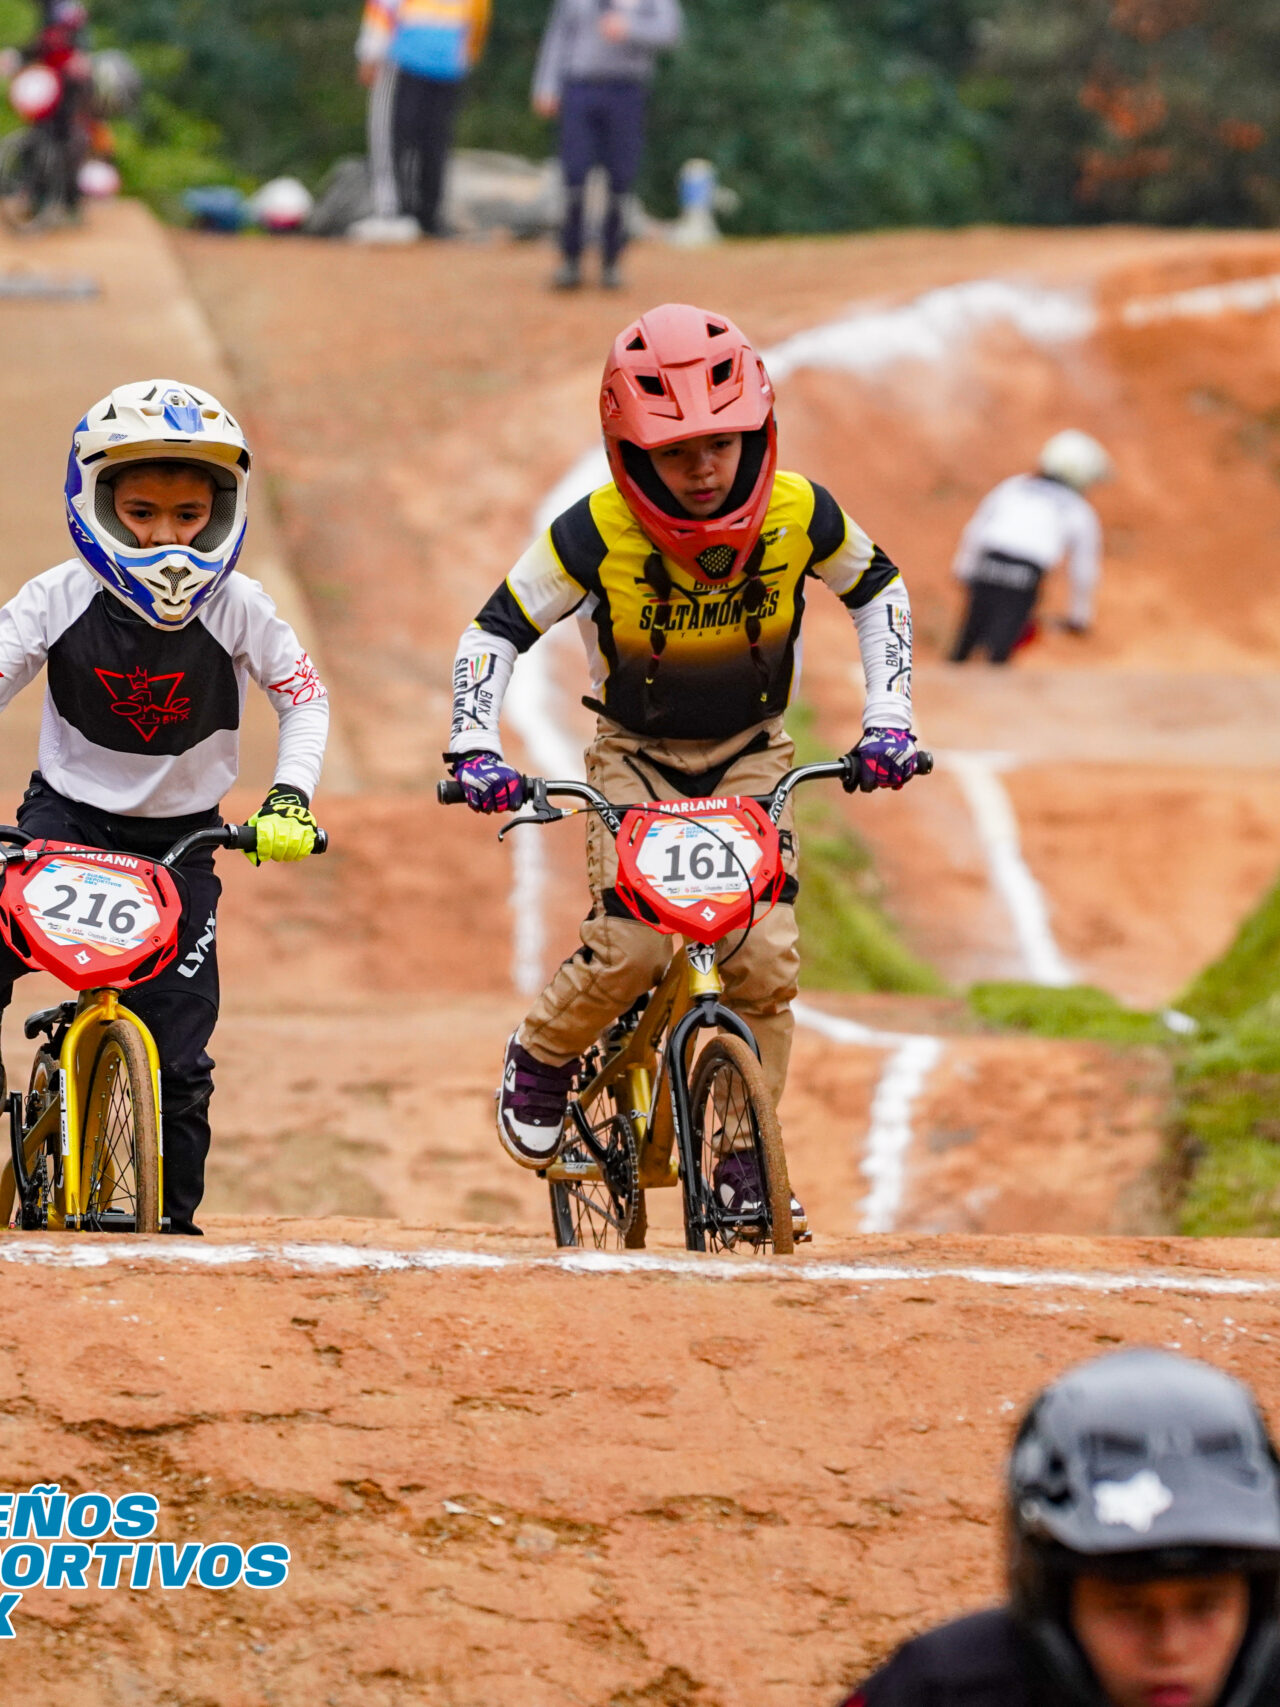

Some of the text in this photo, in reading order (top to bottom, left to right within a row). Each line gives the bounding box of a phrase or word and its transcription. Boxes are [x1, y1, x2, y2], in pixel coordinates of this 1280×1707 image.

[885, 642, 899, 667] BMX
[478, 689, 493, 716] BMX
[658, 798, 728, 815] MARLANN
[63, 845, 140, 870] MARLANN
[662, 840, 740, 882] 161
[41, 884, 142, 934] 216
